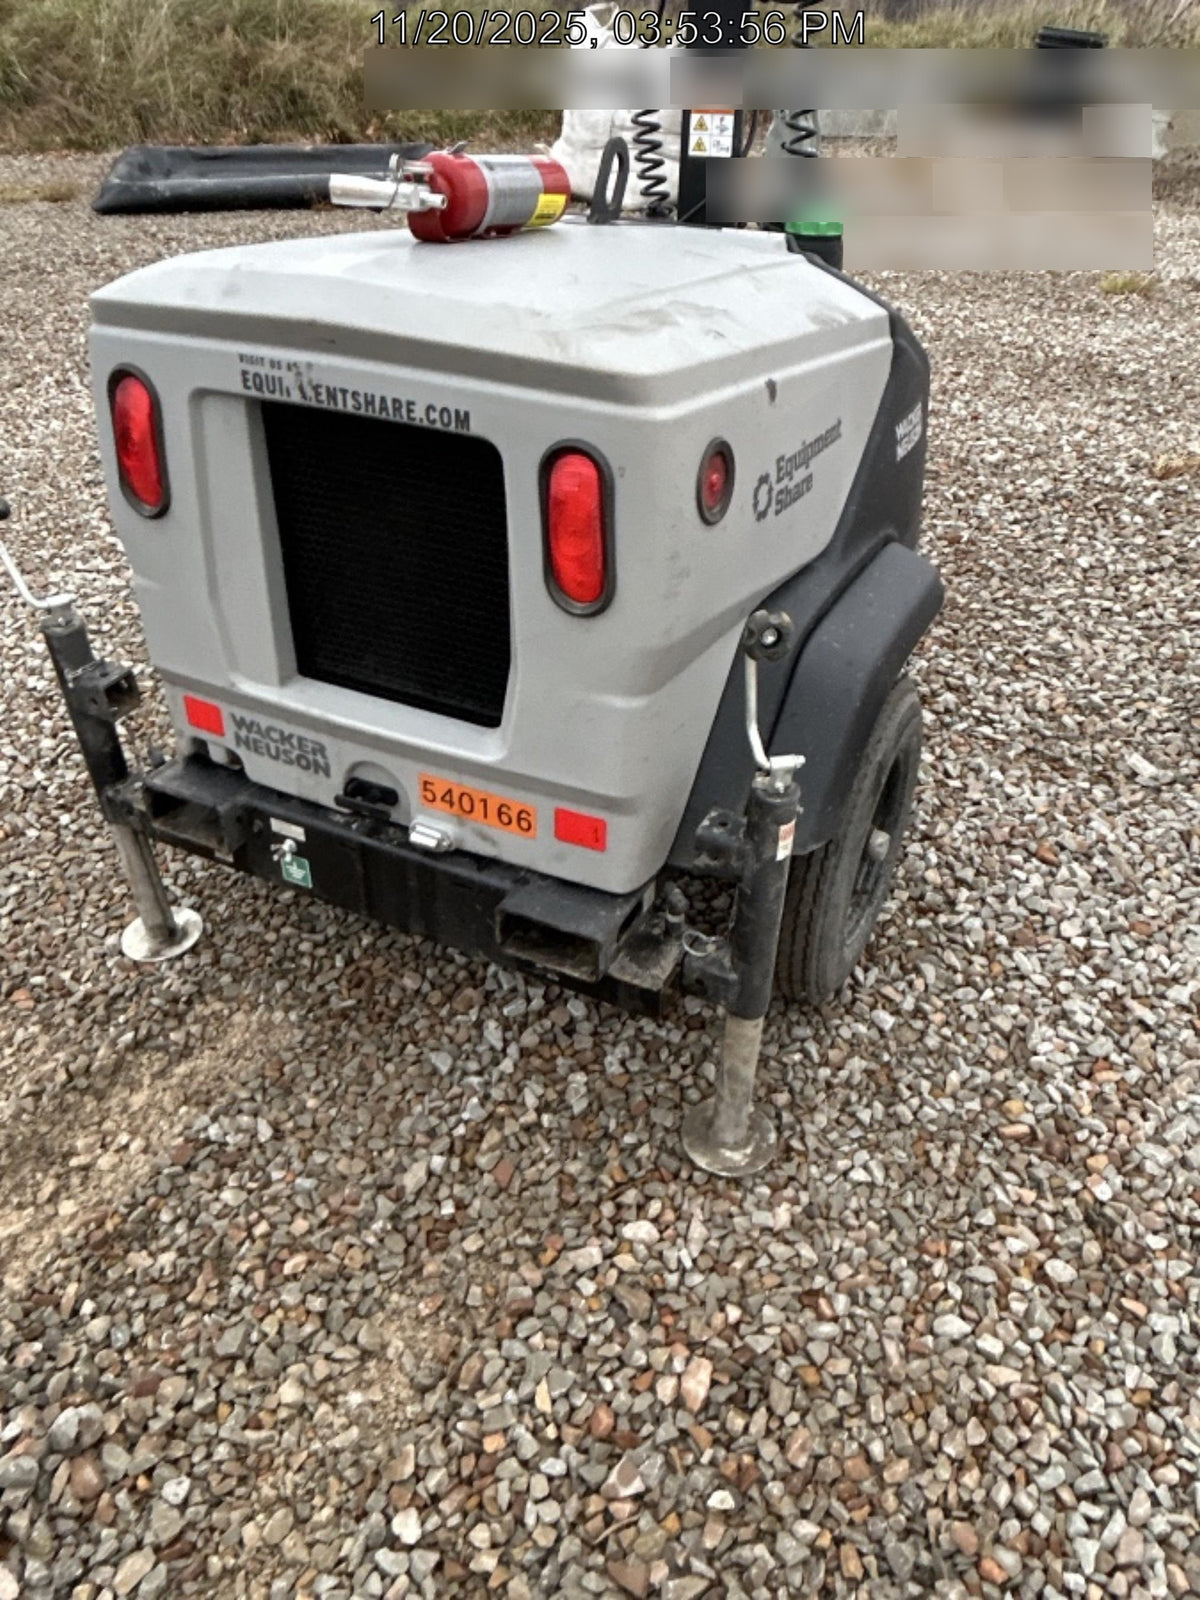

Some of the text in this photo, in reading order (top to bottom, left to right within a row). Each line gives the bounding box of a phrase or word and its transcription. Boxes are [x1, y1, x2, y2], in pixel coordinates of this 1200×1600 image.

[240, 369, 471, 432] EQUIENTSHARE.COM
[775, 417, 843, 485] Equipment
[774, 472, 814, 517] Share
[230, 712, 328, 761] WACKER
[234, 731, 331, 779] NEUSON
[421, 779, 534, 833] 540166
